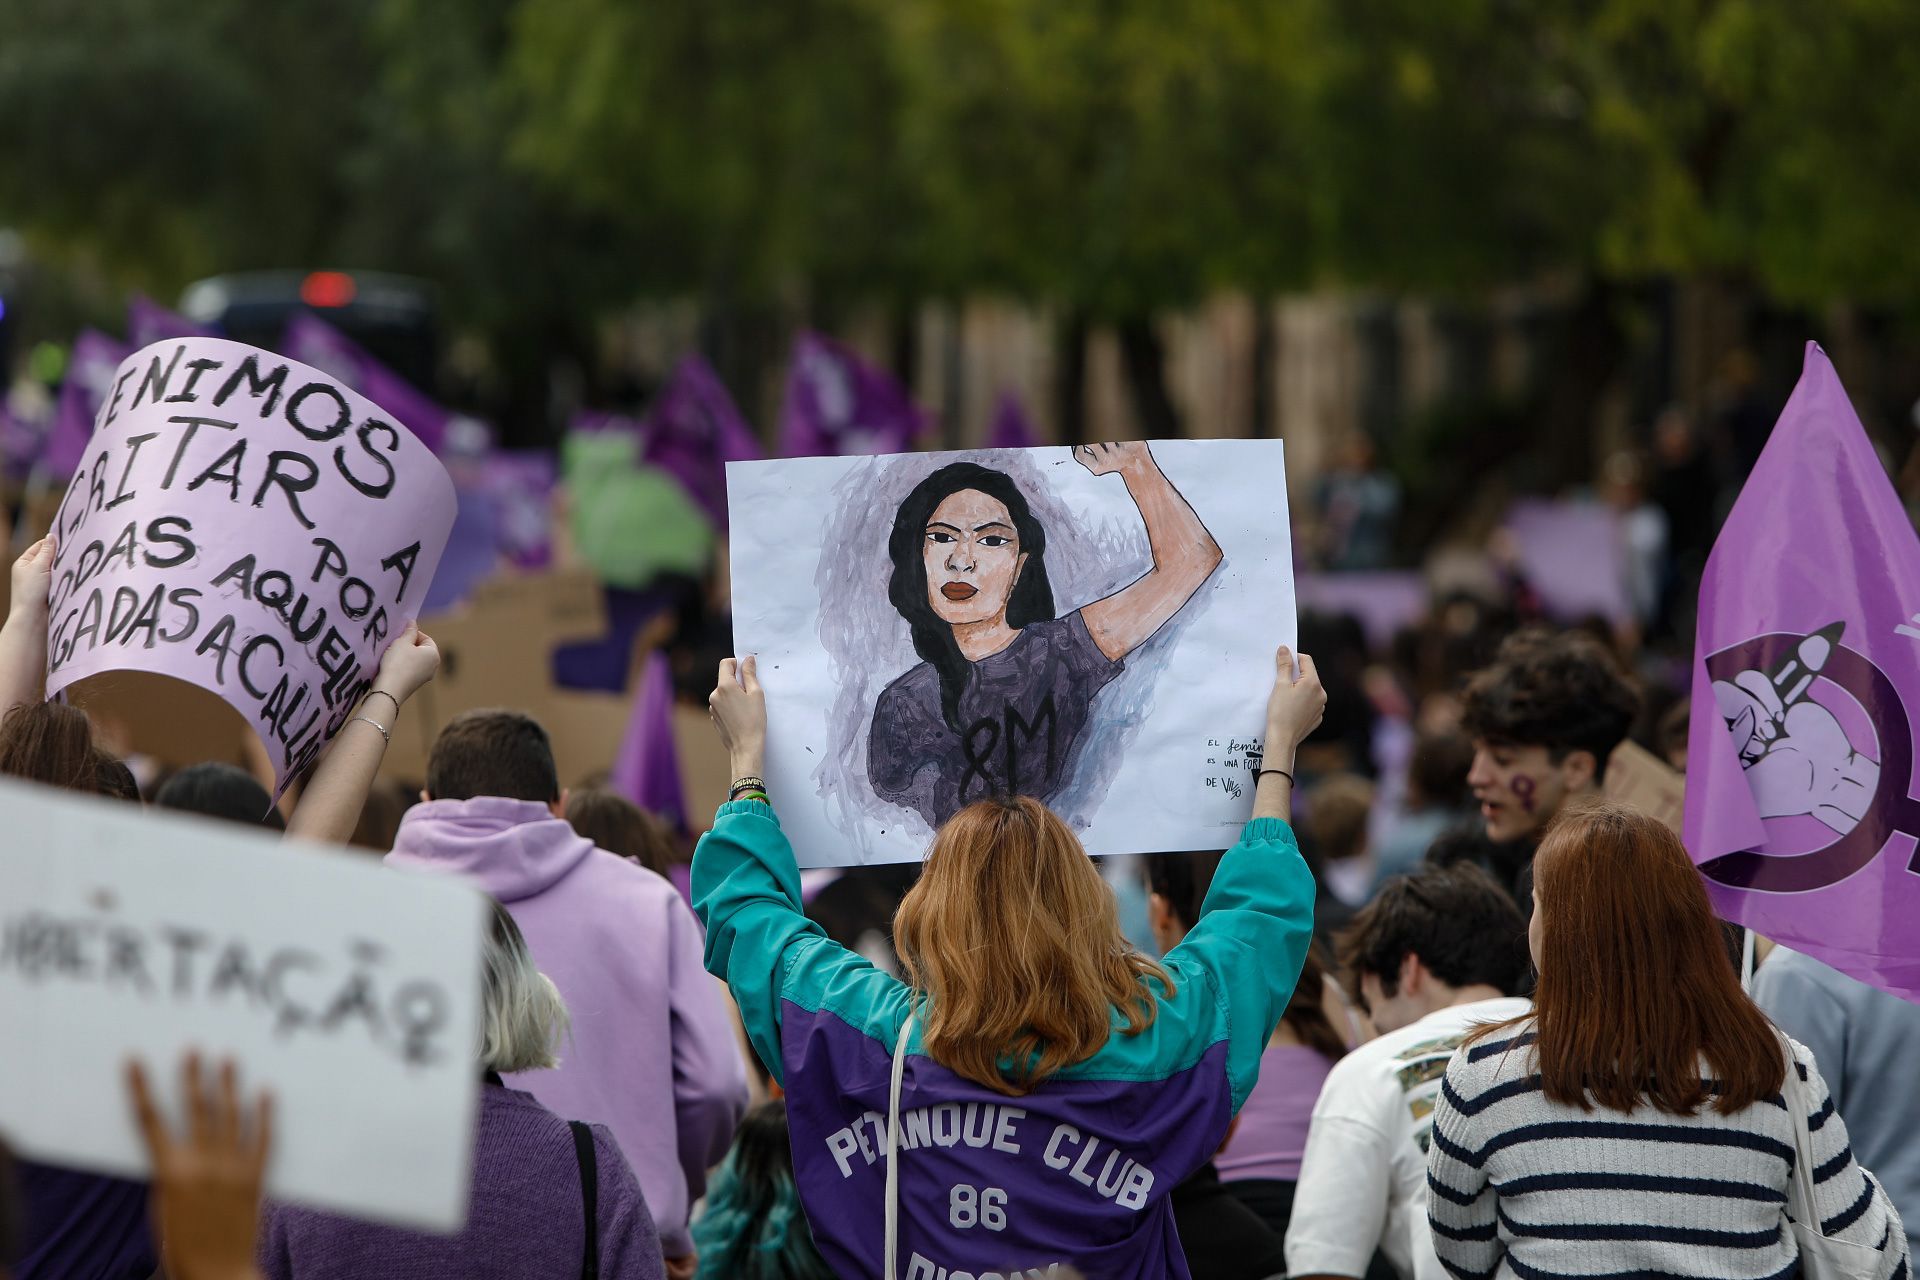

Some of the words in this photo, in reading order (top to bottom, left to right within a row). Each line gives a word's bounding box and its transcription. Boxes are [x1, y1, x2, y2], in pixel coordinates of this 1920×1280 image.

[97, 345, 400, 499] ENIMOS
[382, 541, 421, 604] A
[50, 515, 197, 626] ODAS
[53, 415, 319, 570] GRITAR
[311, 537, 389, 655] POR
[50, 583, 202, 674] IGADAS
[196, 613, 236, 687] A
[1206, 777, 1217, 788] DE
[1207, 739, 1220, 747] EL
[1226, 738, 1264, 754] femin
[1207, 757, 1216, 765] ES
[1224, 758, 1239, 769] UNA
[949, 1183, 1008, 1231] 86
[1043, 1123, 1155, 1211] CLUB
